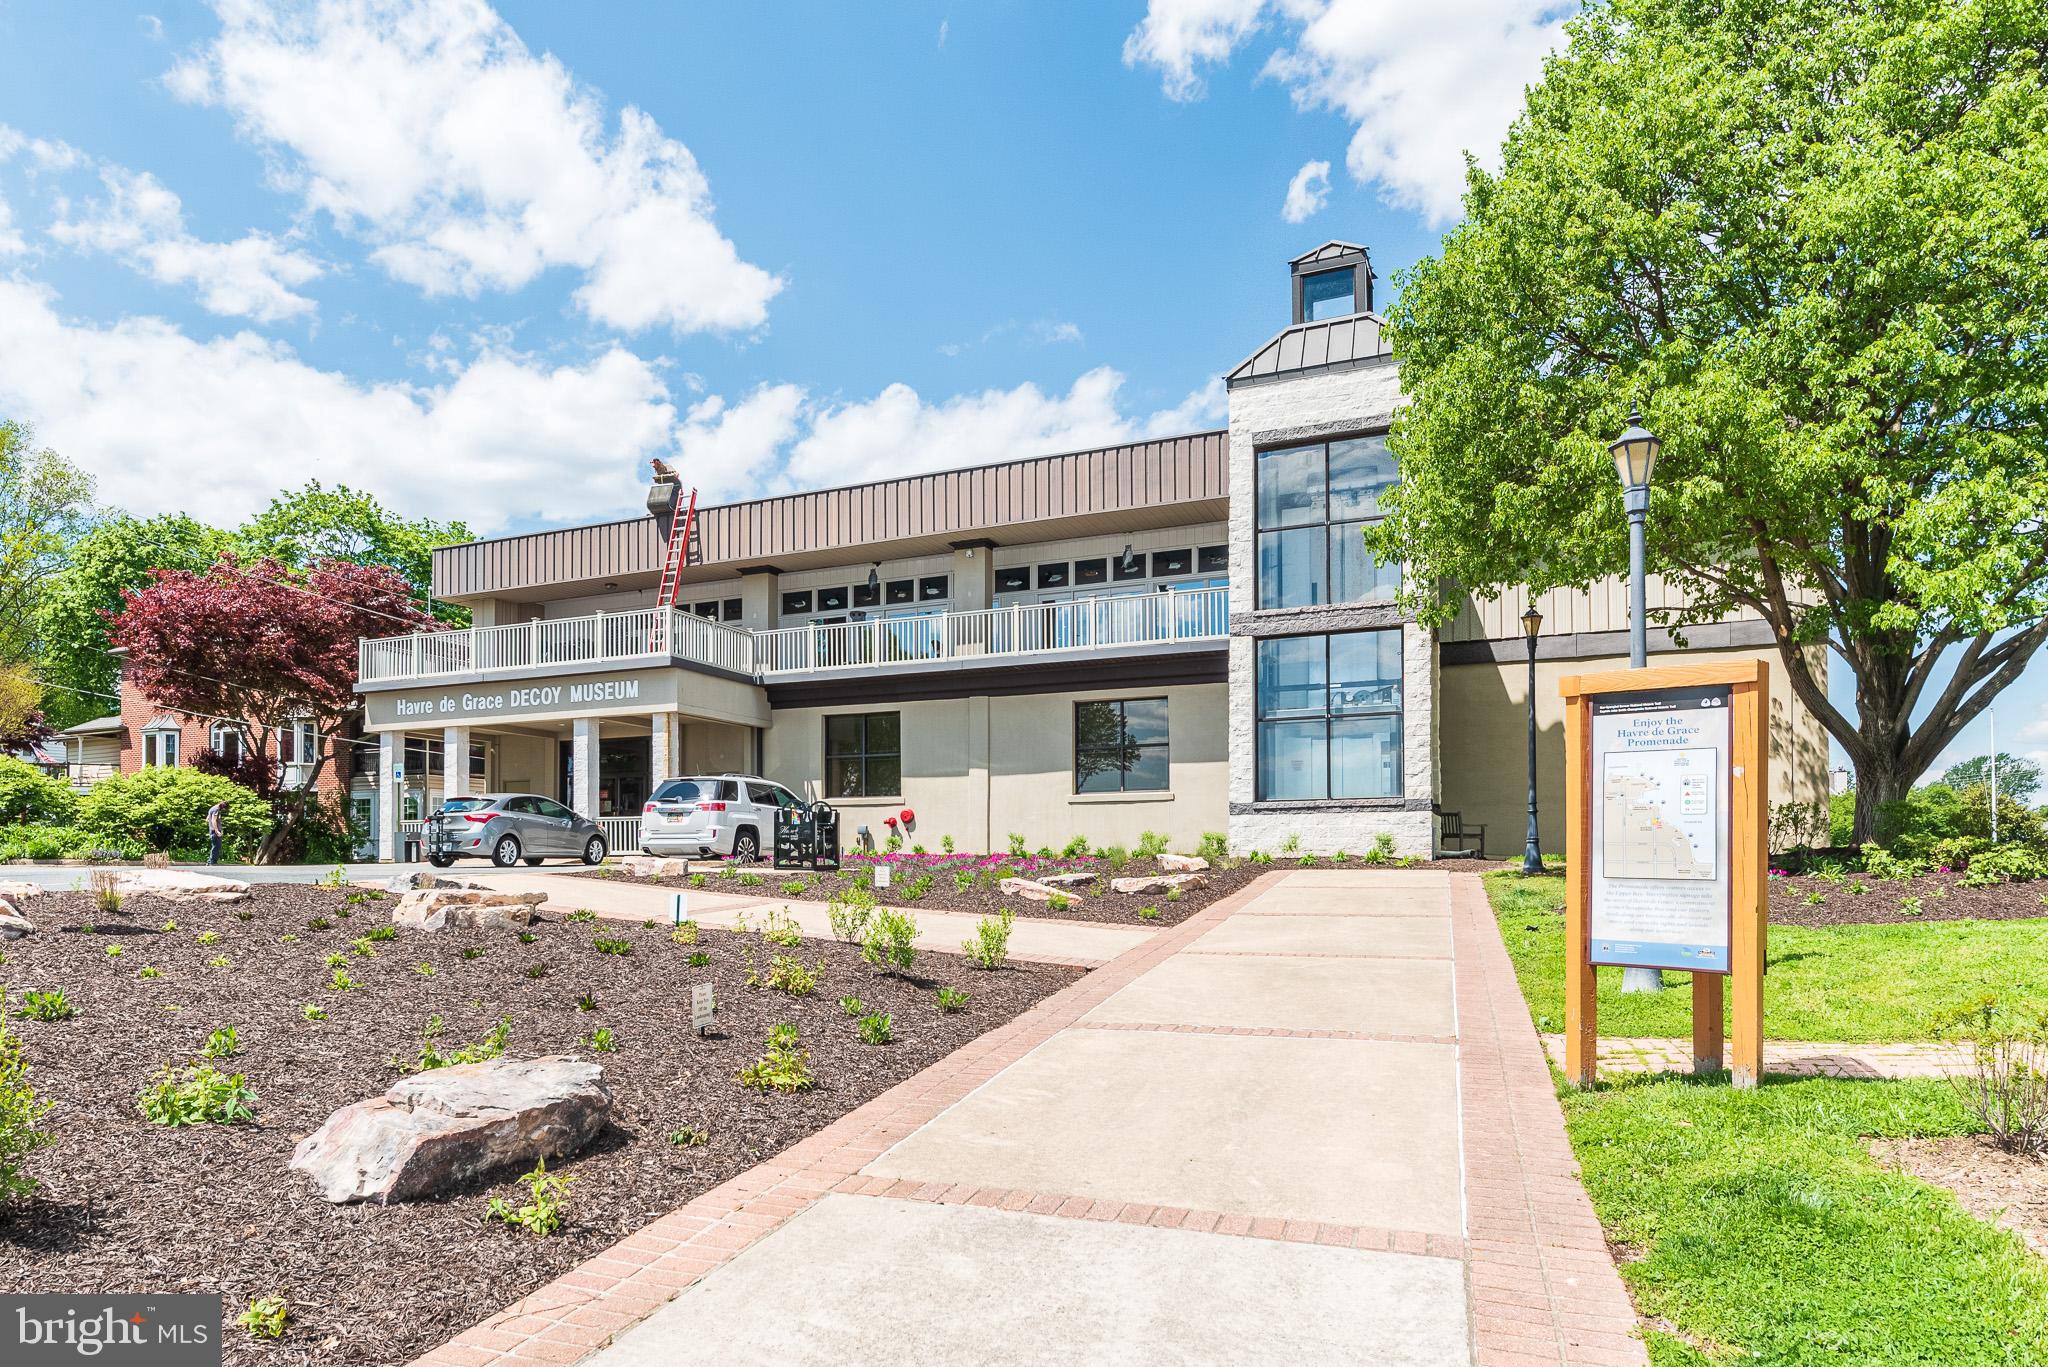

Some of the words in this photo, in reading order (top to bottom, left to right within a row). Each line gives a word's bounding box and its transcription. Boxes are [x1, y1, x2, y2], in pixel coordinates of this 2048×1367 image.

[396, 698, 434, 716] Havre
[440, 695, 456, 713] de
[462, 693, 504, 711] Grace
[510, 686, 562, 708] DECOY
[570, 680, 639, 703] MUSEUM
[1633, 718, 1662, 729] Enjoy
[1666, 716, 1683, 726] the
[1617, 729, 1648, 738] Havre
[1652, 727, 1662, 736] de
[1667, 726, 1700, 736] Grace
[1627, 736, 1689, 747] Promenade
